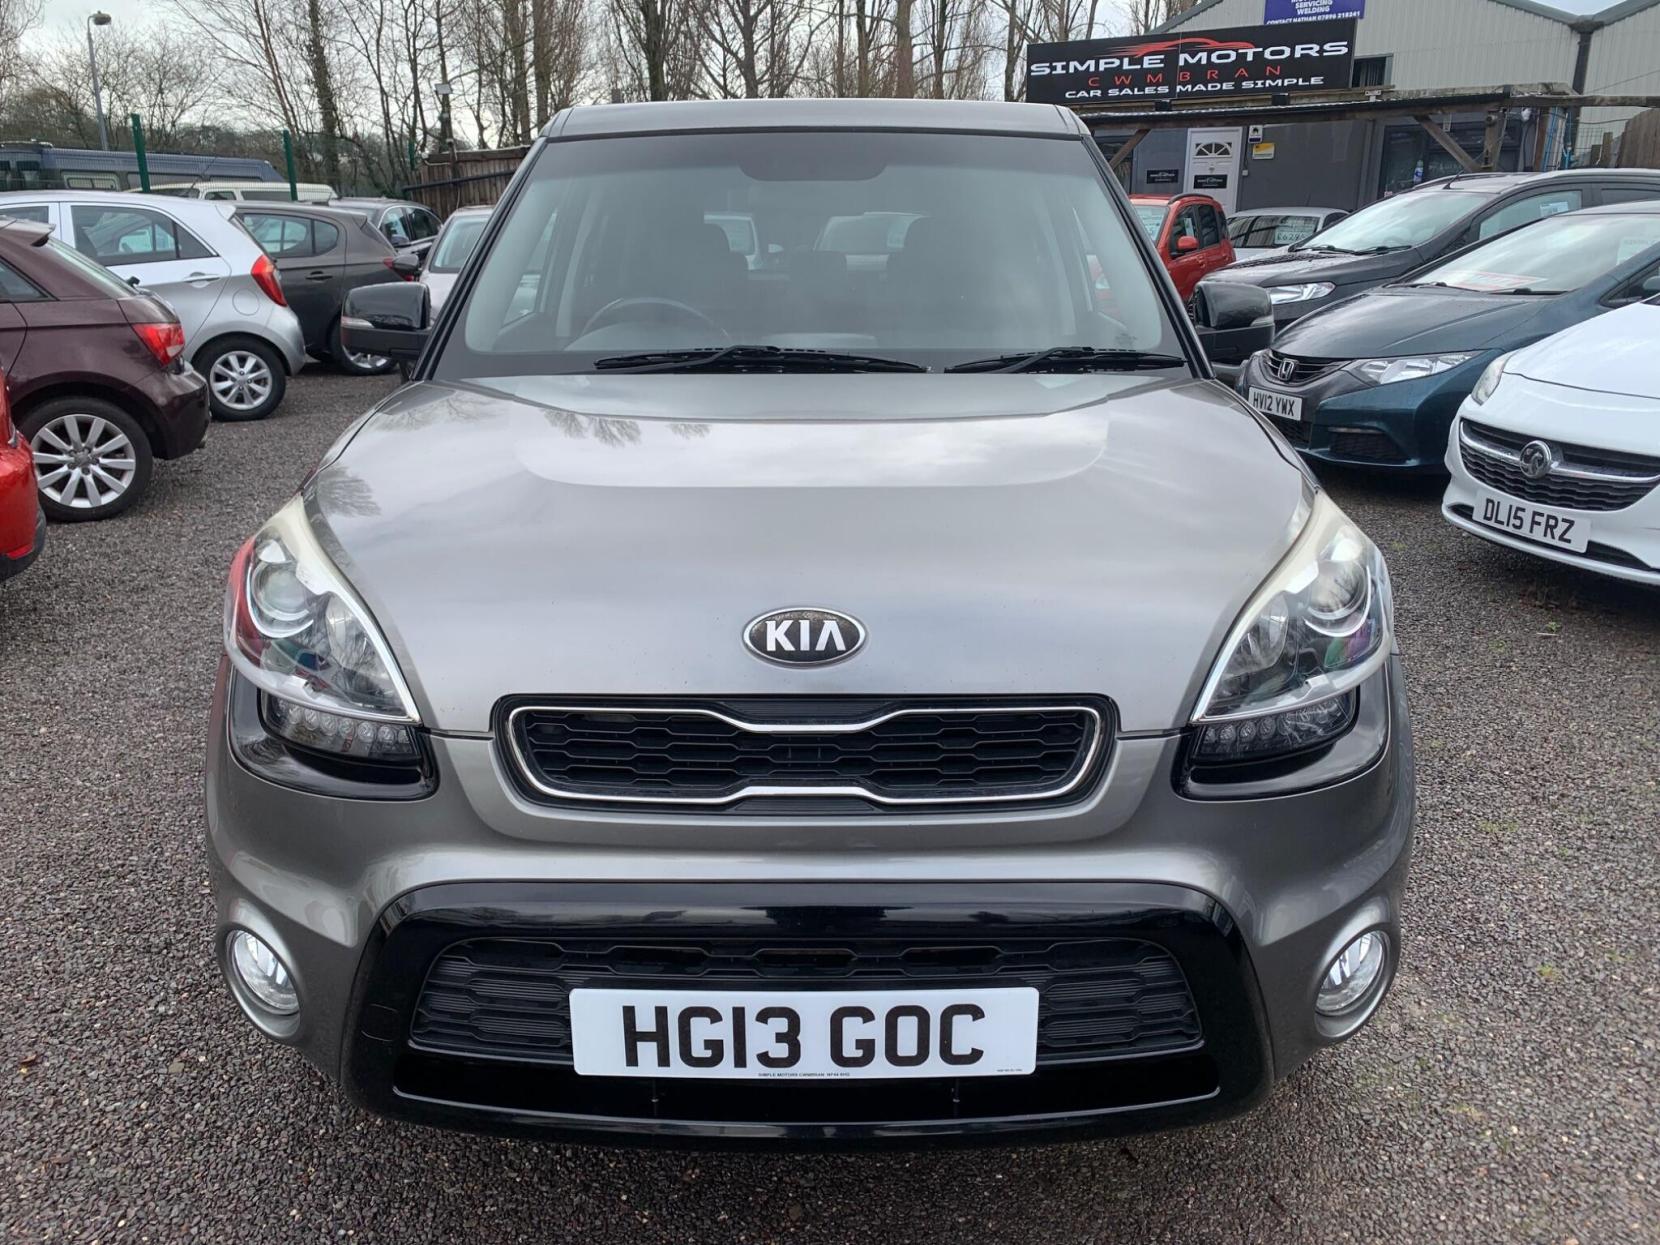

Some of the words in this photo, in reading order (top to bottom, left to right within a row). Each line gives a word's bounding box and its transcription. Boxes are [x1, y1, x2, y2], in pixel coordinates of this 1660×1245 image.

[1295, 0, 1333, 9] SERVICING
[1297, 6, 1330, 15] WELDING
[1030, 55, 1165, 76] SIMPLE
[1178, 41, 1349, 66] MOTORS
[1065, 89, 1101, 98] CAR
[1108, 86, 1169, 96] SALES
[1176, 82, 1235, 93] MADE
[1241, 76, 1325, 89] SIMPLE
[1087, 65, 1281, 87] CWMBRAN
[1253, 391, 1273, 411] HV12
[1276, 396, 1295, 416] YWX
[1483, 498, 1526, 530] DL15
[1529, 510, 1575, 544] FRZ
[765, 619, 846, 651] KIA
[622, 1005, 802, 1069] HG13
[829, 1003, 986, 1068] GOC
